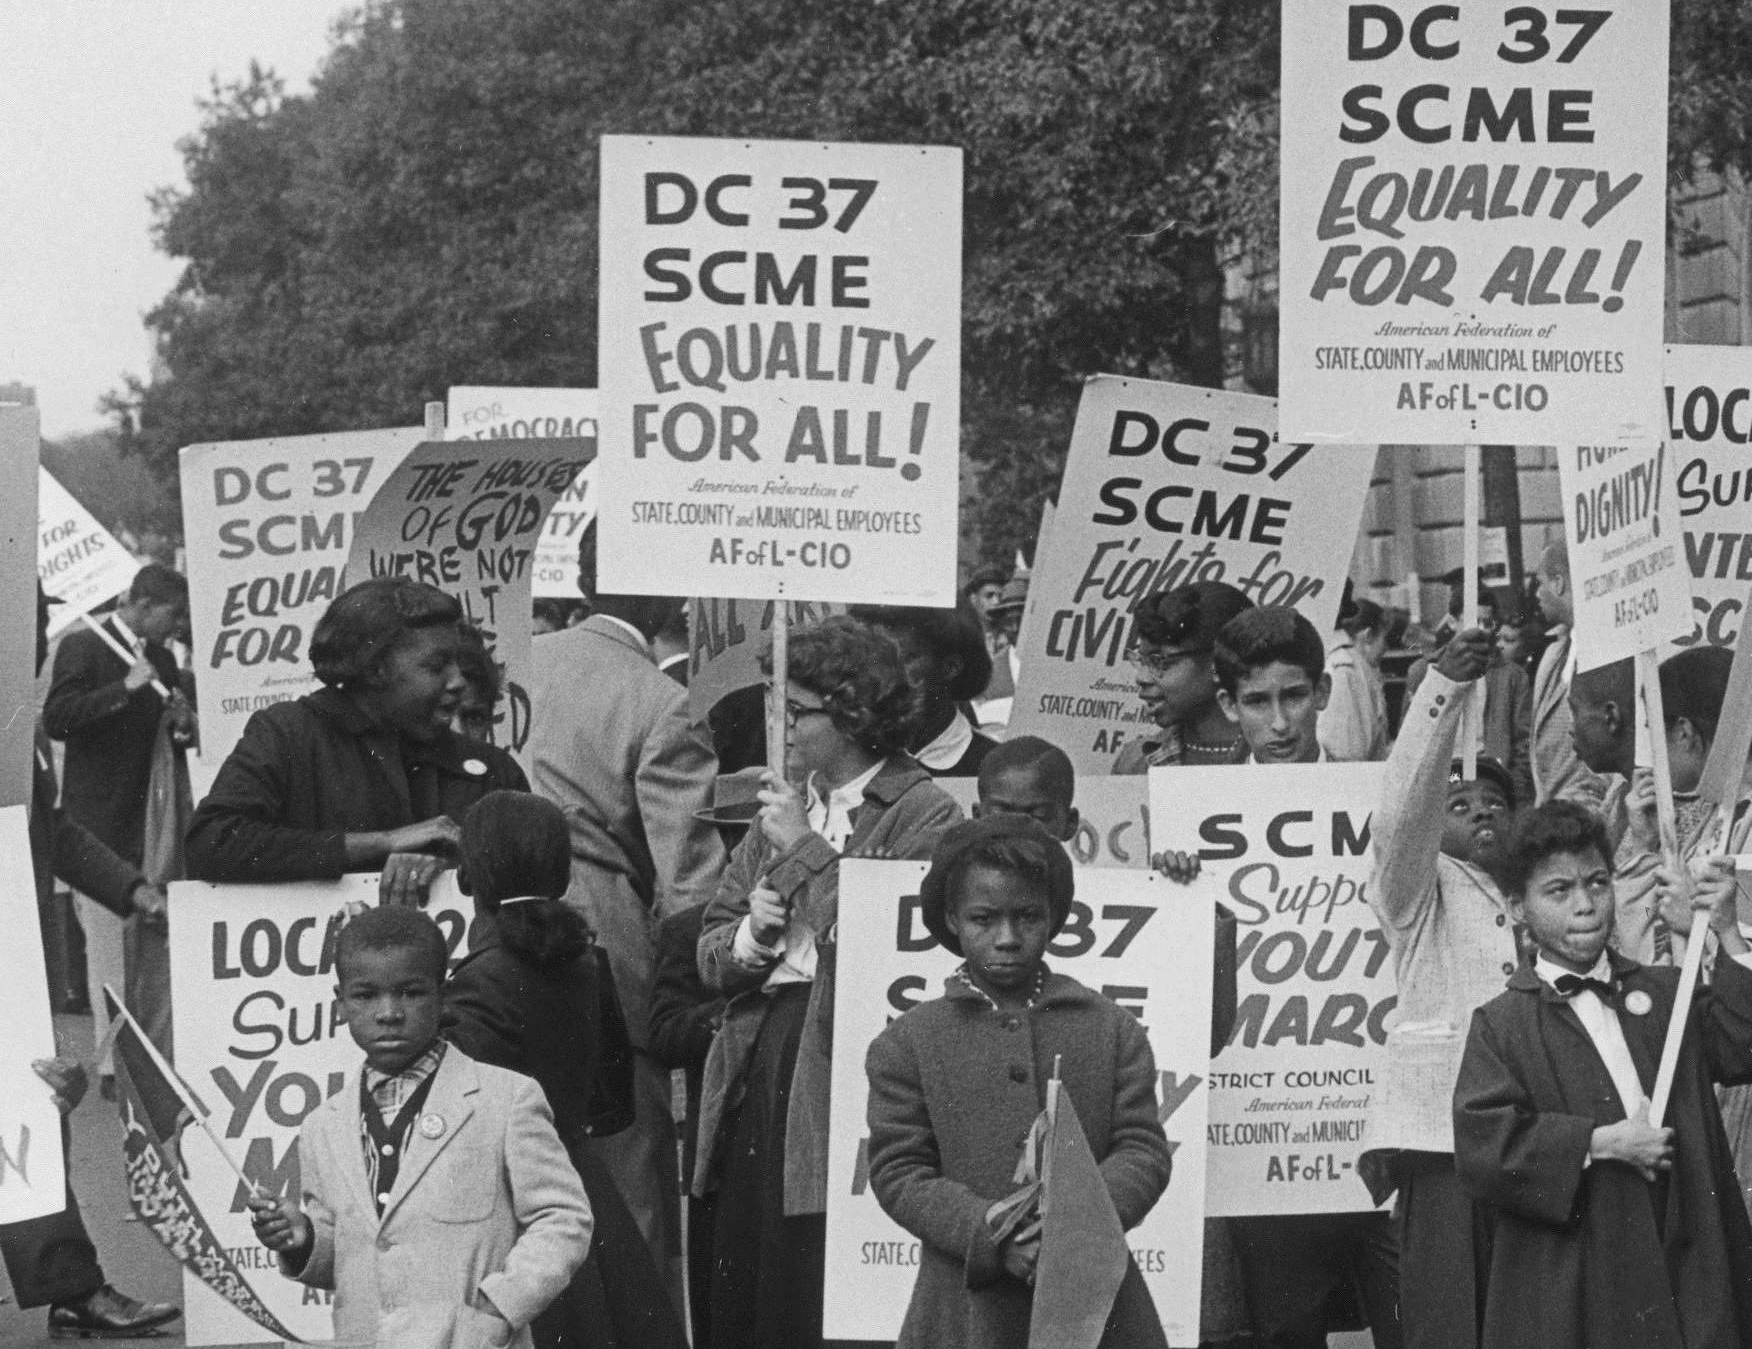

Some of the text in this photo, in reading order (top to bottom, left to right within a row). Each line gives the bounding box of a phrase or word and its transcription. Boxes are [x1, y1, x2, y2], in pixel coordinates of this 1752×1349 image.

[1348, 4, 1613, 64] DC 37
[1339, 84, 1595, 144] SCME
[645, 172, 879, 234] DC 37
[1317, 156, 1643, 241] EQUALITY
[644, 248, 870, 308] SCME
[1310, 239, 1643, 313] FOR ALL!
[640, 321, 936, 394] EQUALITY
[1375, 322, 1556, 338] American Federation of
[1447, 349, 1526, 371] MUNICIPAL
[1532, 350, 1623, 373] EMPLOYEES
[633, 401, 930, 481] FOR ALL!
[1109, 410, 1314, 481] DC 37
[213, 457, 374, 506] DC 37
[407, 460, 479, 502] THE
[689, 479, 859, 498] American Federation of
[1576, 441, 1664, 544] DIGNITY!
[218, 512, 365, 559] SCM
[455, 491, 541, 551] GOD
[756, 506, 832, 530] MUNICIPAL
[836, 510, 921, 534] EMPLOYEES
[1093, 477, 1291, 545] SCME
[478, 545, 533, 584] NOT
[211, 624, 301, 669] FOR
[1199, 810, 1373, 860] SCM
[1245, 1096, 1313, 1113] American
[1285, 1069, 1374, 1087] COUNCIL
